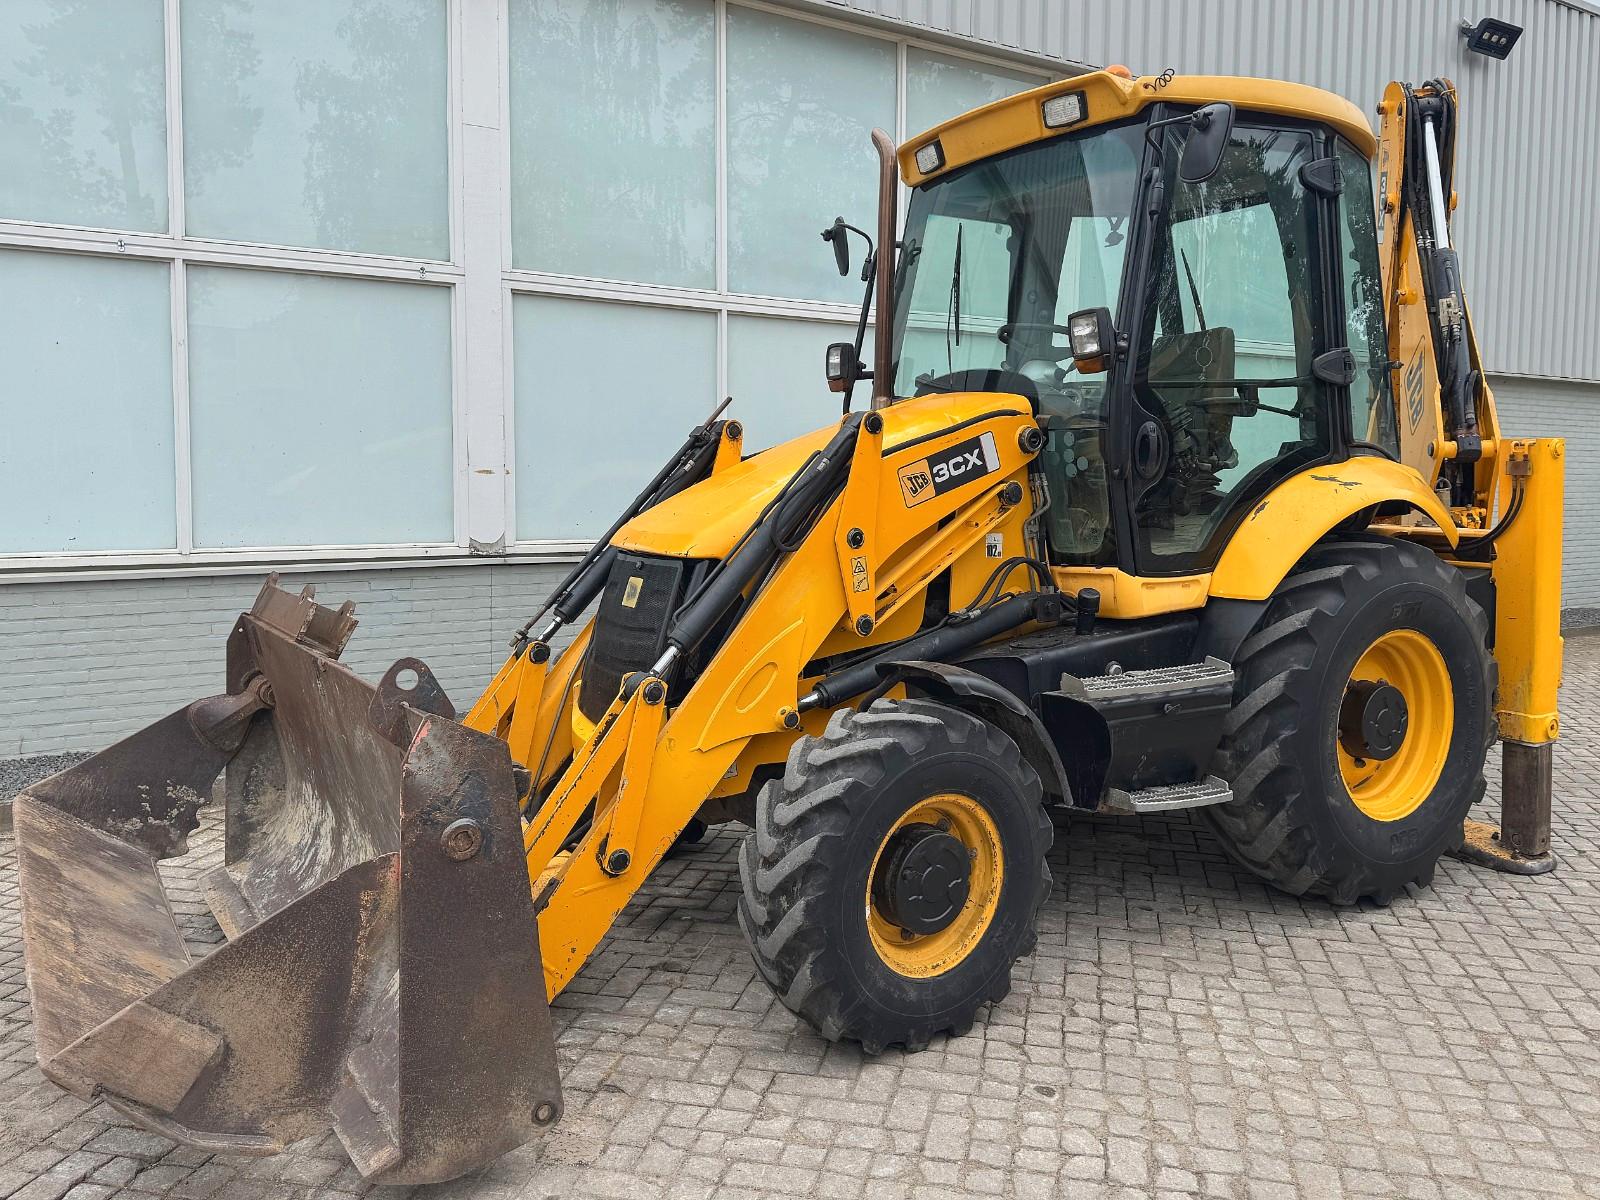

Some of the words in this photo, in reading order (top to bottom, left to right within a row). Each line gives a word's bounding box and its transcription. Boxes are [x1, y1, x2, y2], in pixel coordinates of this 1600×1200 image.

[1406, 351, 1424, 428] JCB
[907, 473, 929, 495] JCB
[933, 447, 983, 483] 3CX
